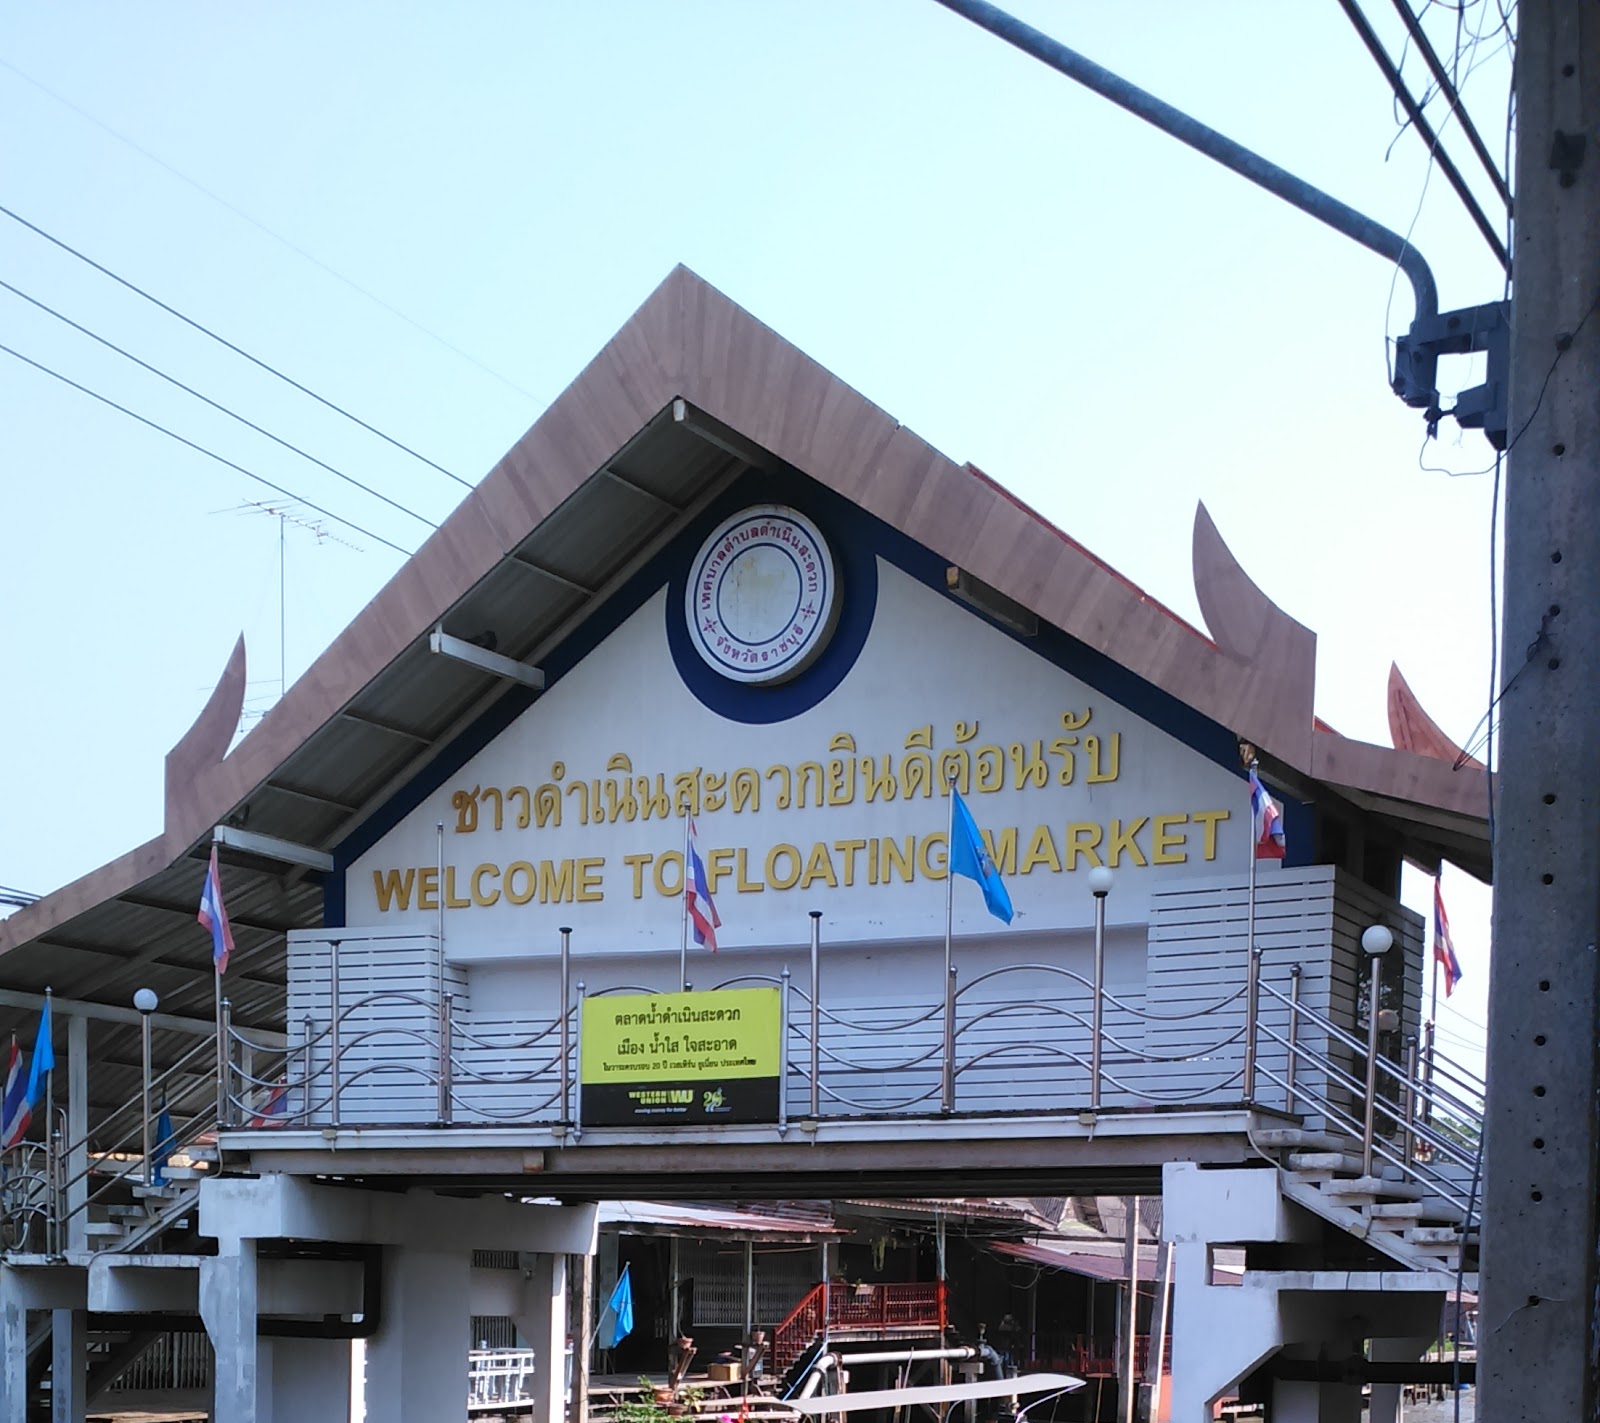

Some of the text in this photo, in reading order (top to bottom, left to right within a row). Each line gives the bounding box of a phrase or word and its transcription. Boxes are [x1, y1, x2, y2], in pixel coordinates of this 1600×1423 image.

[452, 707, 1121, 834] ชาวดำเนินสะดวกยินดีต้อนรับ
[373, 810, 1230, 912] WELCOME TO FLOATING MARKET
[615, 1002, 741, 1026] ตลาดน้ำดำเนินสะดวก
[683, 1035, 738, 1053] ใจสะอาด
[628, 1091, 667, 1099] WESTERN
[640, 1097, 667, 1105] UNION
